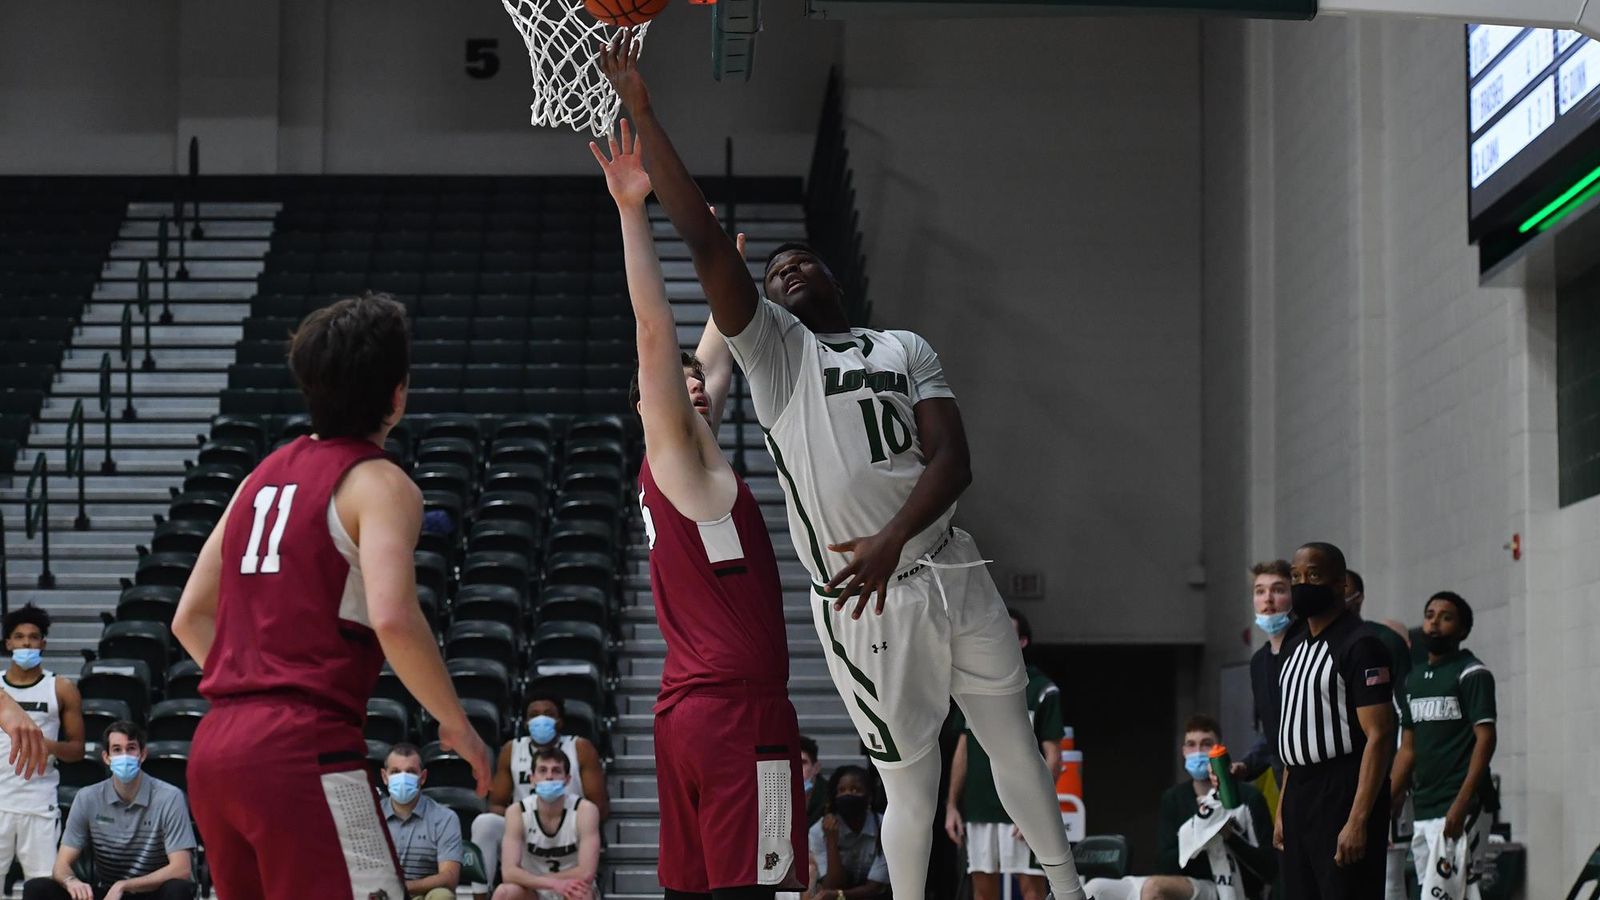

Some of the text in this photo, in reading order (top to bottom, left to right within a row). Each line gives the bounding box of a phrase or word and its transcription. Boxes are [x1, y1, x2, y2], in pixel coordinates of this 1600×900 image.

[466, 38, 500, 79] 5
[857, 398, 913, 464] 10
[240, 484, 298, 574] 11
